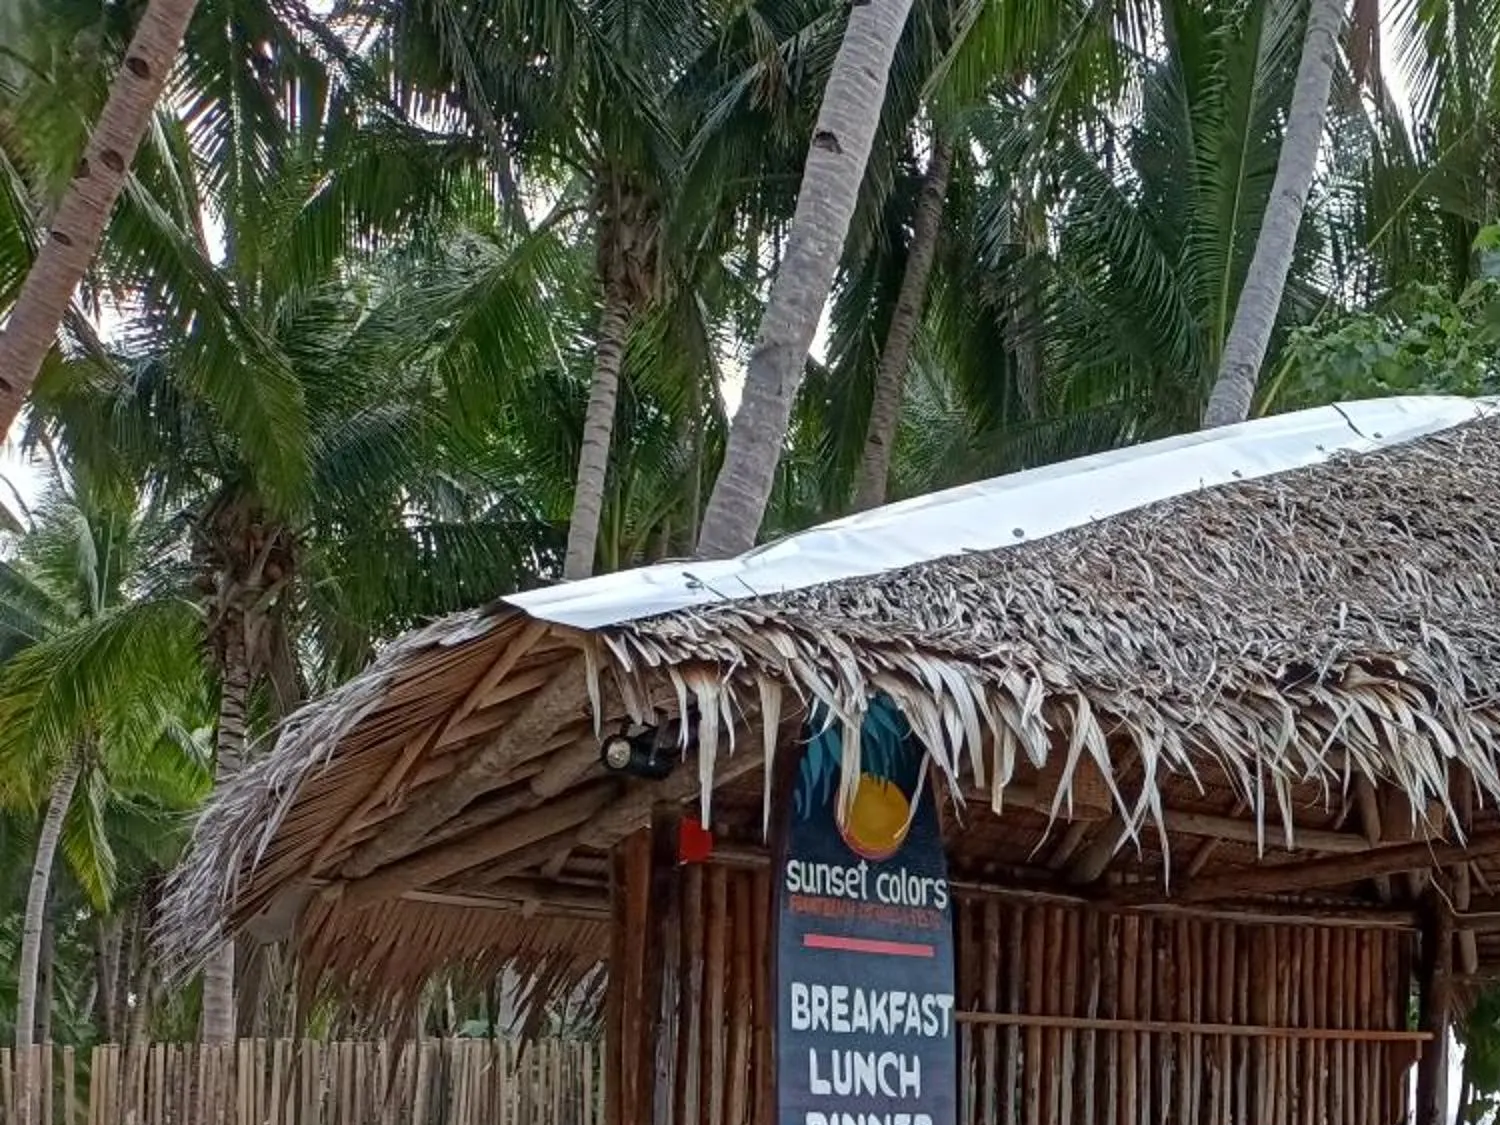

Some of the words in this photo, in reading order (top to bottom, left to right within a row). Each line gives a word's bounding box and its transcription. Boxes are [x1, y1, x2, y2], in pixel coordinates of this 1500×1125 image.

[786, 859, 868, 900] sunset
[876, 867, 947, 909] colors
[791, 982, 954, 1038] BREAKFAST
[809, 1048, 921, 1099] LUNCH
